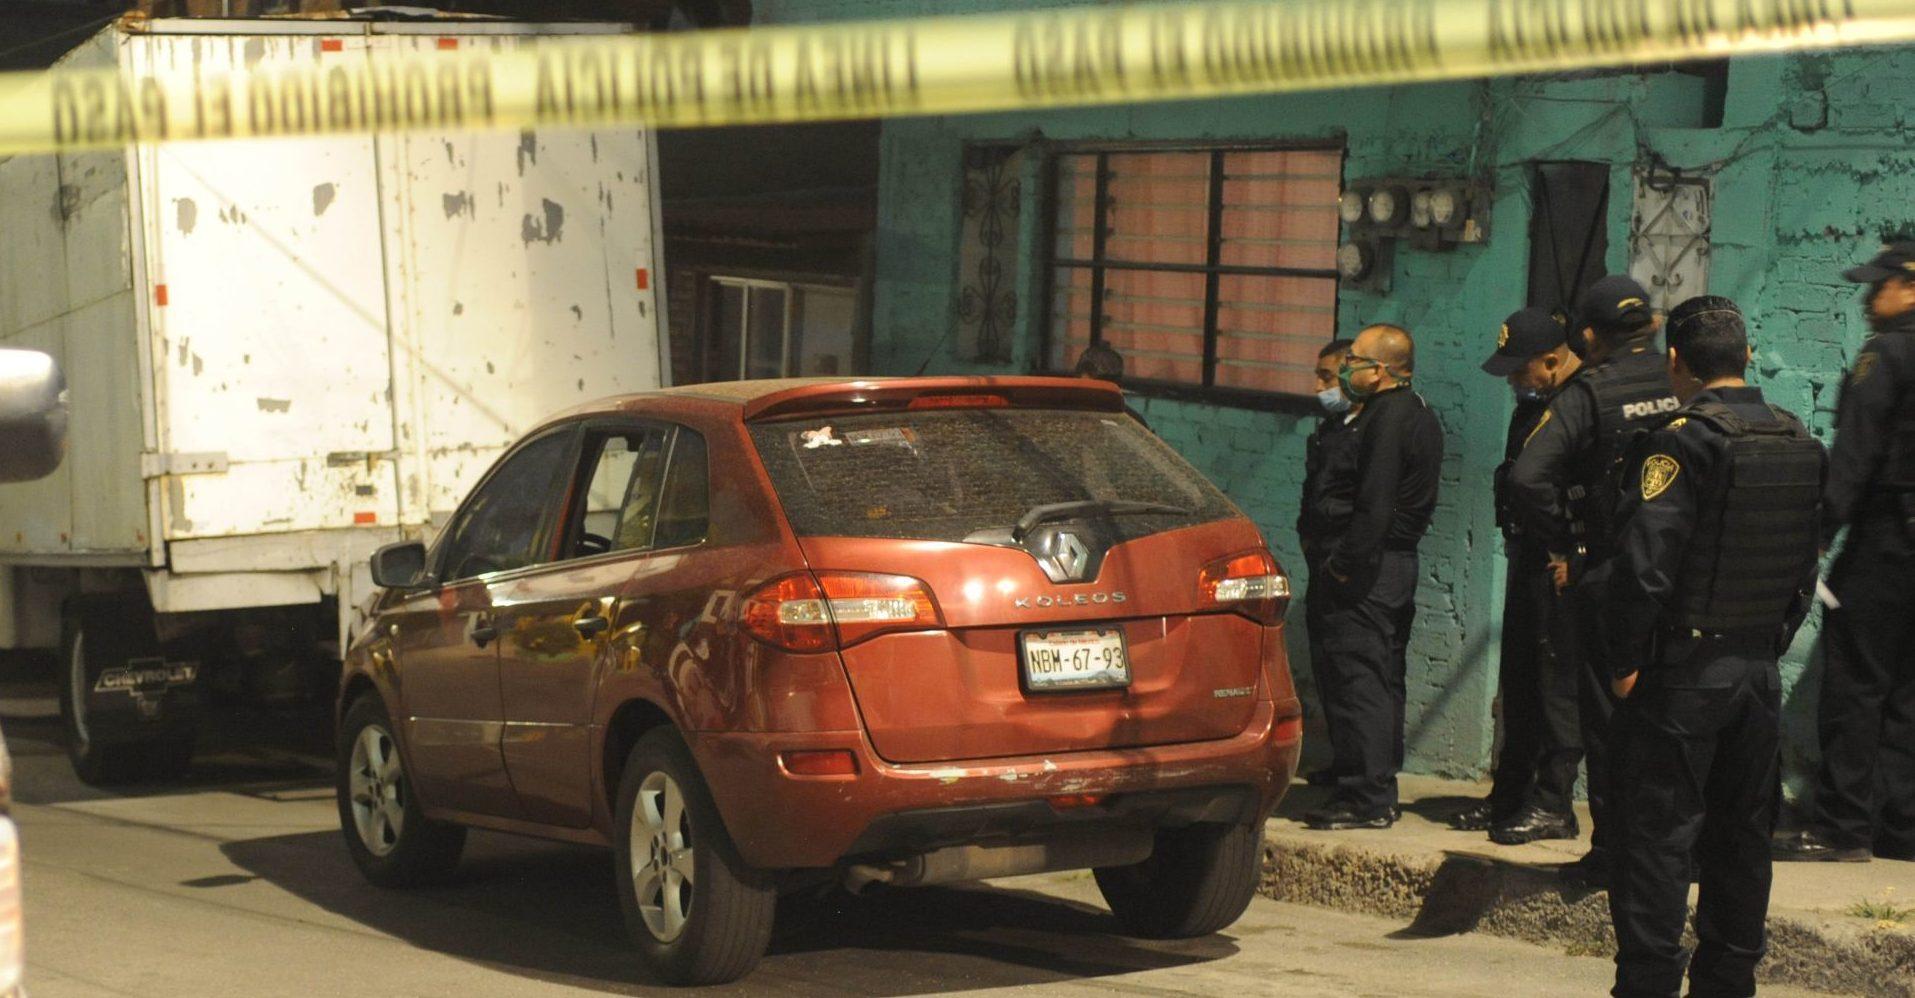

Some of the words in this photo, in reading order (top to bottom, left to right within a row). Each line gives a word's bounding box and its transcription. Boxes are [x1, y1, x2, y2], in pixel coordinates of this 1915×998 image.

[1622, 396, 1681, 419] POLICI
[1014, 592, 1126, 608] KOLEOS
[1030, 647, 1124, 673] NBM-67-93
[104, 666, 193, 686] CHEVROLET
